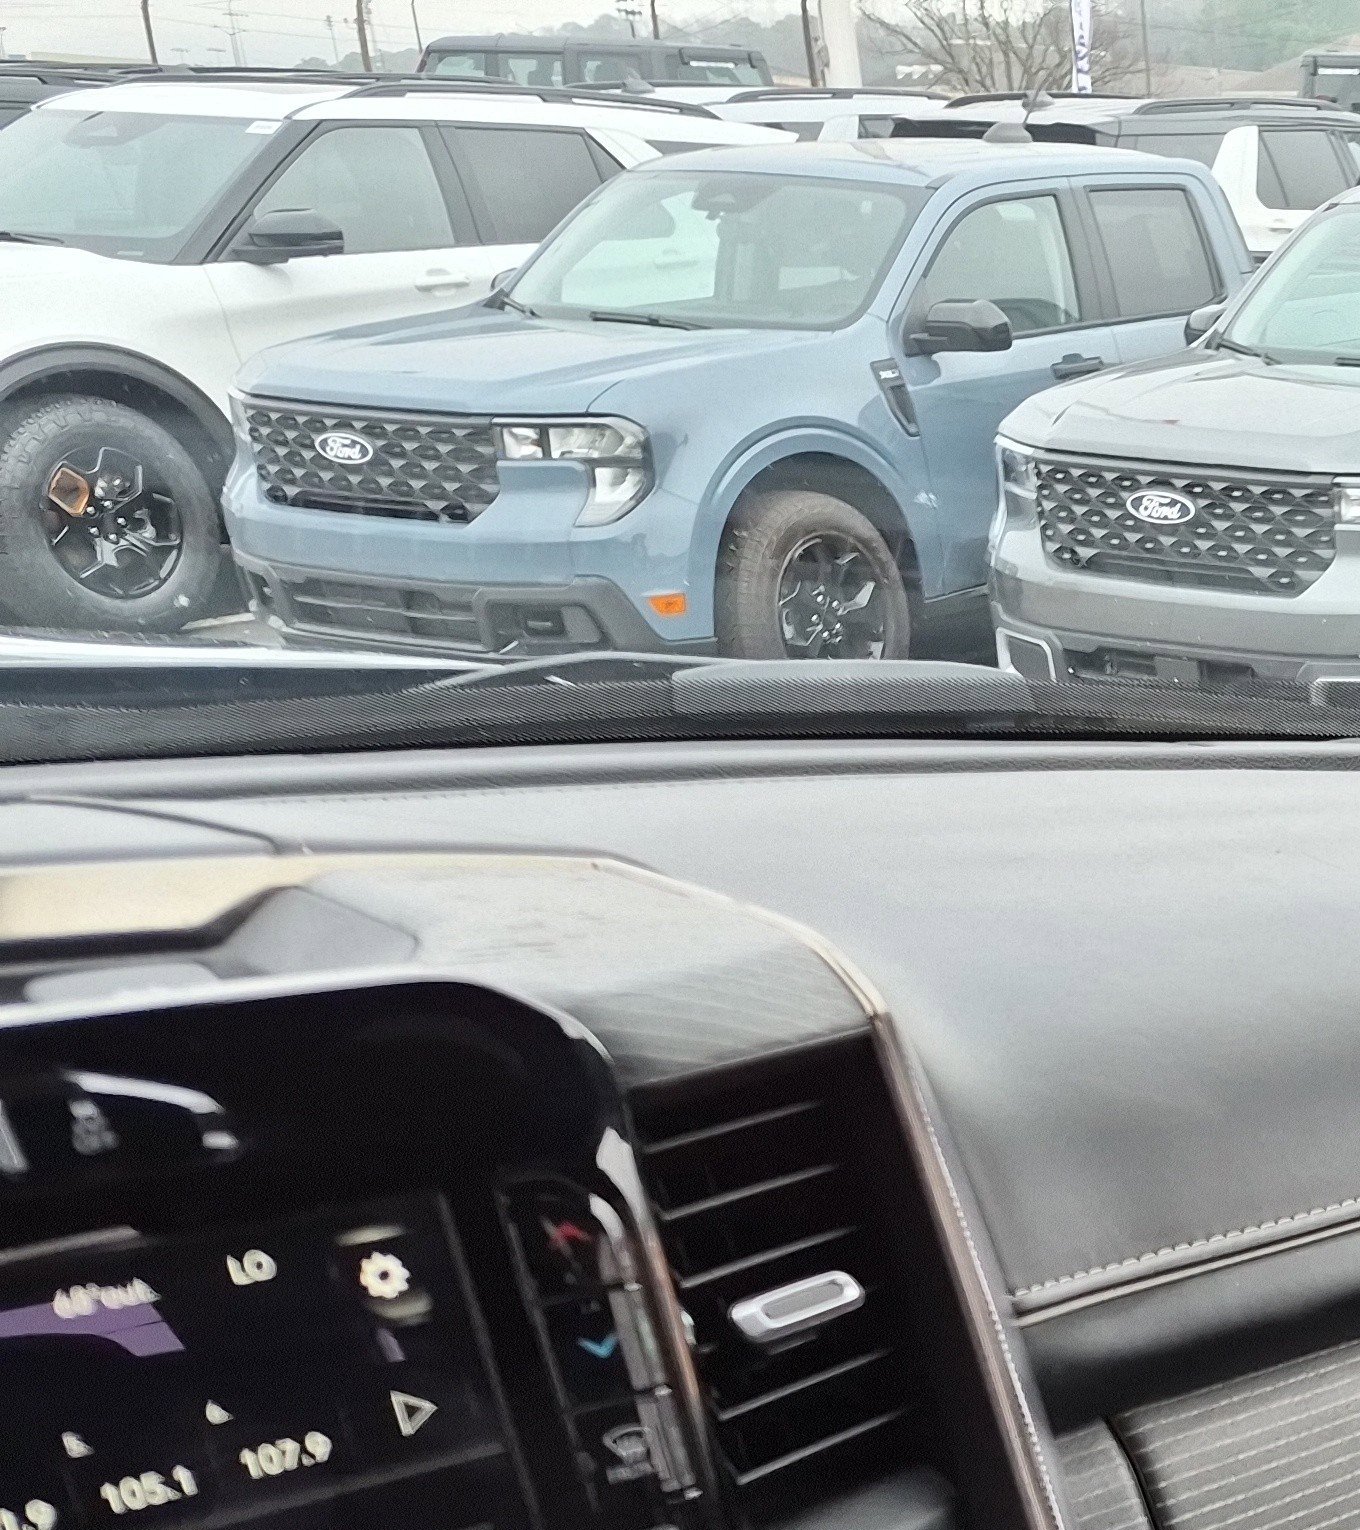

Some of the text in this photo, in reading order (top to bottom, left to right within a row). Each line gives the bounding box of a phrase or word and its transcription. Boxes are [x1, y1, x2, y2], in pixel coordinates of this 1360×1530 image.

[326, 436, 362, 460] Ford
[1138, 495, 1182, 520] Ford
[101, 1464, 198, 1514] 105.1
[240, 1431, 332, 1480] 107.9
